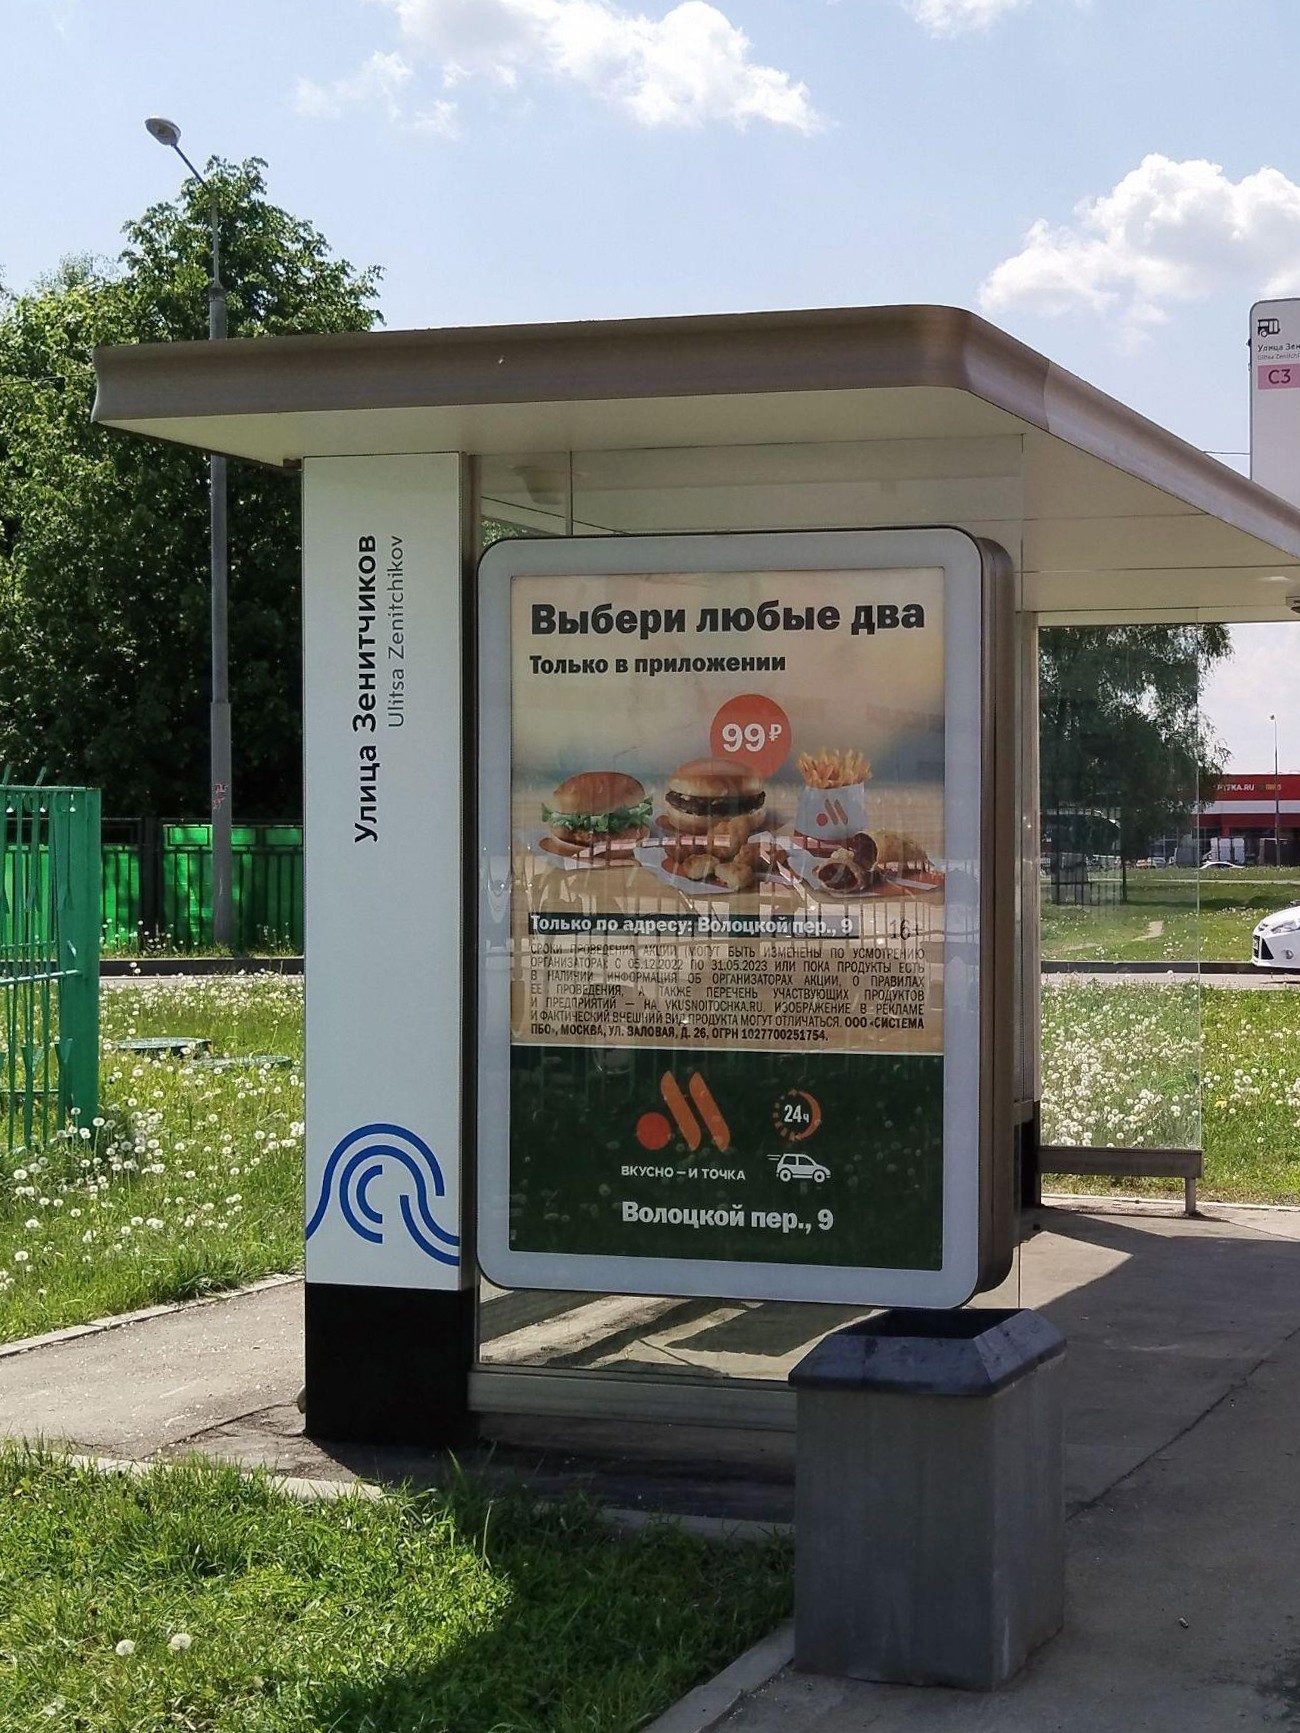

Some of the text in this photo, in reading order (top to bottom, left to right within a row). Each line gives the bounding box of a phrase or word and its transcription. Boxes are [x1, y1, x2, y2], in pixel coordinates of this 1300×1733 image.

[1257, 344, 1283, 352] Улица
[531, 600, 925, 640] Выбери любые два
[387, 535, 404, 728] Ulitsa Zenitchikov
[530, 654, 786, 677] Только в приложении
[352, 535, 380, 843] Улица Зенитчиков
[530, 915, 853, 937] Только по адресу: Волоцкой пер., 9
[890, 919, 923, 940] 16+
[531, 944, 562, 954] СРОКИ
[728, 946, 756, 958] БЫТЬ
[764, 946, 822, 958] ИЗМЕНЕНЫ
[831, 948, 844, 959] ПО
[853, 948, 925, 959] УСМОТРЕНИЮ
[615, 958, 621, 969] С
[628, 959, 683, 970] 05.12.2022
[691, 960, 704, 971] ПО
[712, 960, 767, 971] 31.05.2023
[775, 961, 795, 972] ИЛИ
[804, 961, 830, 972] ПОКА
[837, 962, 891, 974] ПРОДУКТЫ
[899, 963, 925, 973] ЕСТЬ
[531, 970, 537, 980] В
[608, 971, 677, 983] ИНФОРМАЦИЯ
[688, 973, 702, 984] ОБ
[712, 973, 793, 985] ОРГАНИЗАТОРАХ
[804, 975, 842, 988] АКЦИИ,
[852, 976, 860, 987] О
[871, 976, 925, 987] ПРАВИЛАХ
[531, 983, 925, 1002] ЕЕ ПРОВЕДЕНИЯ, А ТАКЖЕ ПЕРЕЧЕНЬ УЧАСТВУЮЩИХ ПРОДУКТОВ
[531, 997, 537, 1007] И
[546, 996, 616, 1009] ПРЕДПРИЯТИЙ
[644, 999, 657, 1010] НА
[775, 1002, 851, 1014] ИЗОБРАЖЕНИЕ
[860, 1003, 867, 1014] В
[877, 1003, 925, 1015] РЕКЛАМЕ
[531, 1010, 537, 1020] И
[540, 1009, 610, 1022] ФАКТИЧЕСКИЙ
[613, 1011, 663, 1024] ВНЕШНИЙ
[688, 1013, 738, 1026] ПРОДУКТА
[741, 1014, 773, 1026] МОГУТ
[775, 1015, 842, 1028] ОТЛИЧАТЬСЯ.
[845, 1016, 867, 1028] ООО
[561, 1024, 606, 1037] МОСКВА,
[608, 1025, 624, 1036] УЛ.
[681, 1027, 691, 1039] Д.
[693, 1027, 709, 1039] 26,
[712, 1028, 739, 1039] ОГРН
[741, 1029, 829, 1041] 1027700251754.
[621, 1166, 674, 1178] ВКУСНО
[688, 1168, 698, 1179] И
[701, 1169, 746, 1181] ТОЧКА
[622, 1201, 834, 1235] Волоцкой пер., 9
